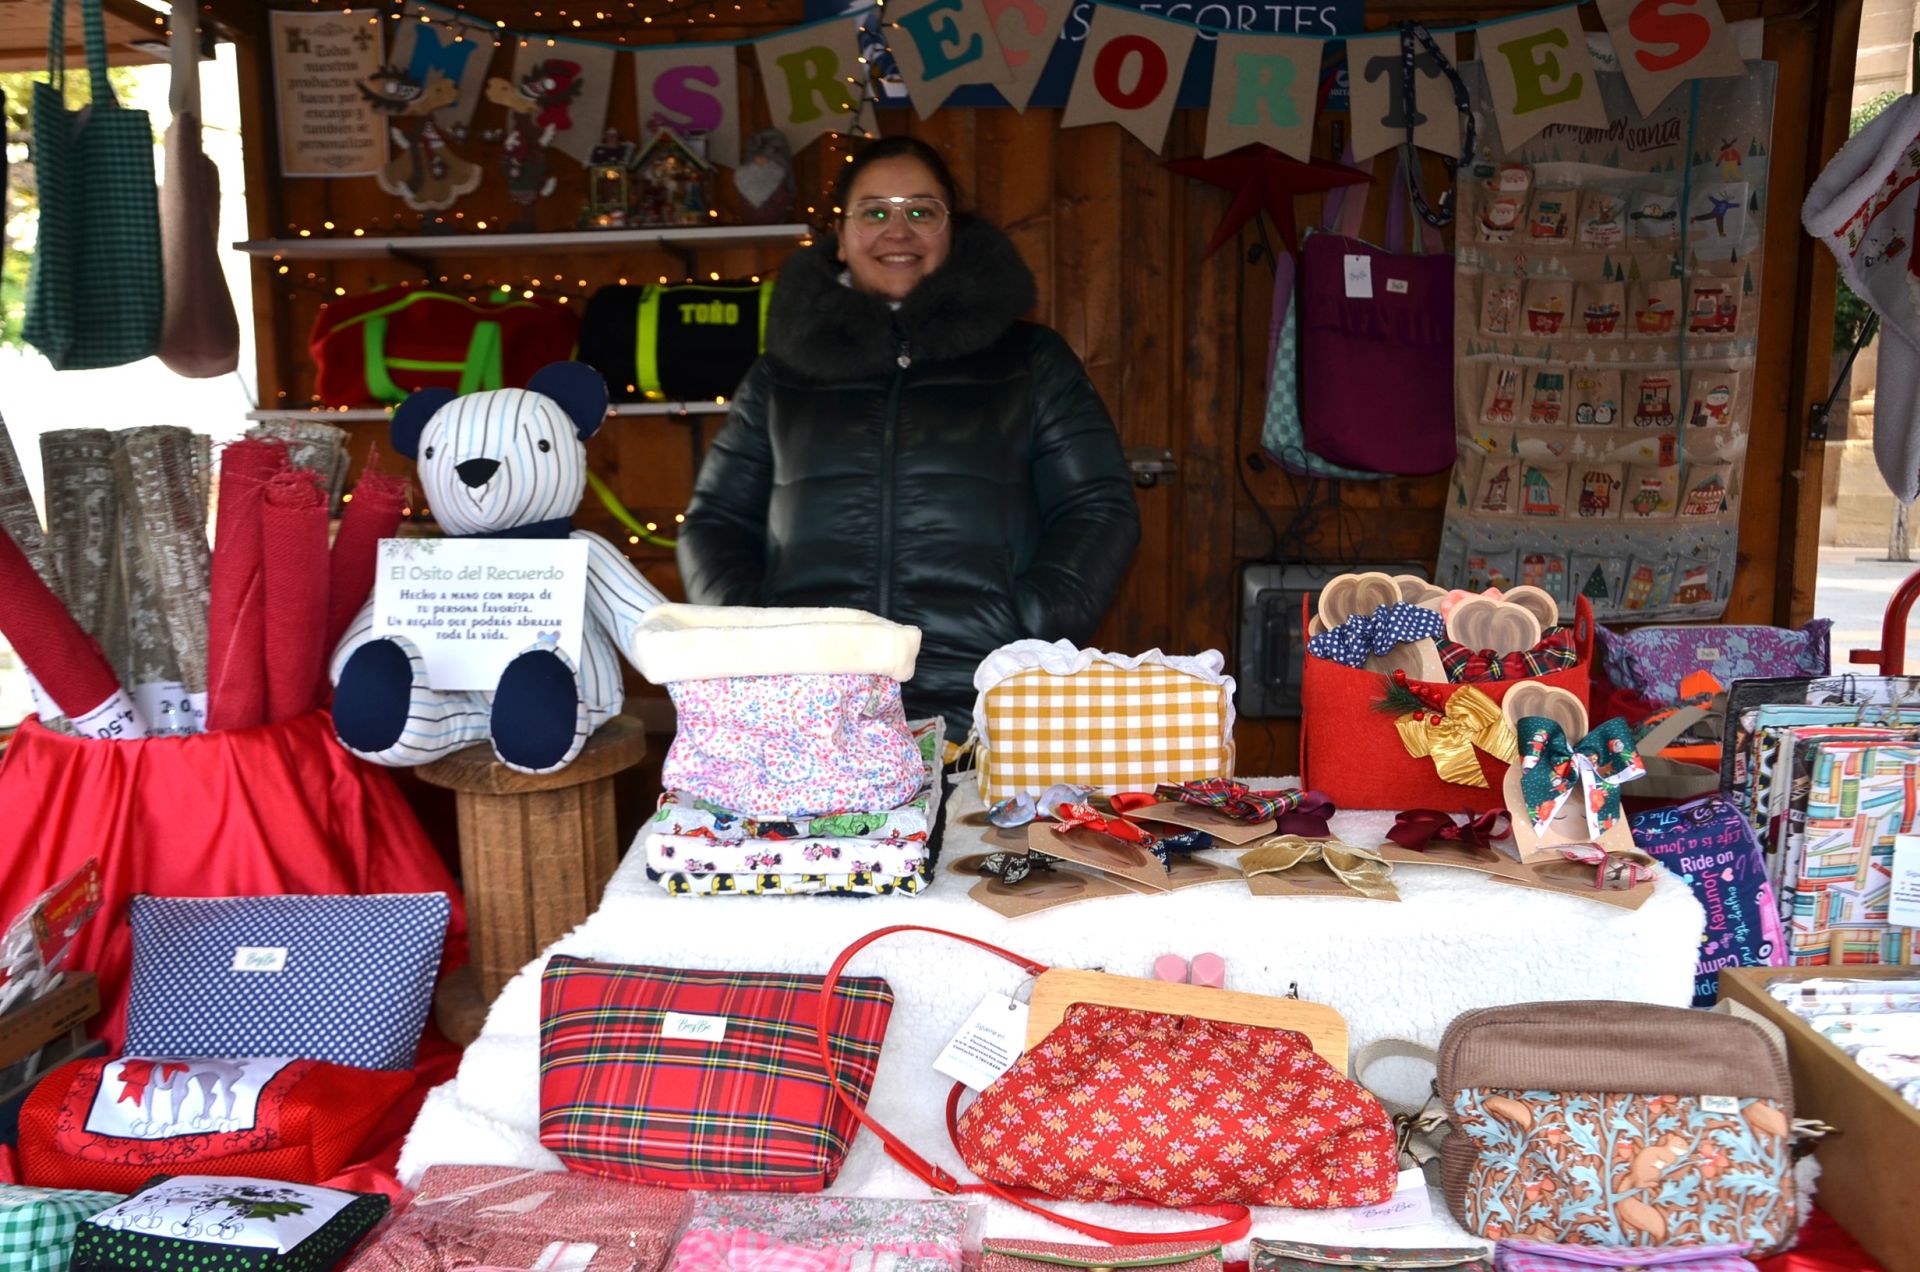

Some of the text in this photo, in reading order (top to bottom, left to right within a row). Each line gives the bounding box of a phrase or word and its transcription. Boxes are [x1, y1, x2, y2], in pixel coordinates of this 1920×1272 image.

[678, 299, 739, 325] TOÑO
[390, 565, 564, 581] El Osito del Recuerdo
[1701, 836, 1713, 848] is
[1717, 826, 1743, 848] Life
[1680, 854, 1714, 874] Ride
[1716, 851, 1735, 865] on
[1702, 870, 1728, 932] Journey
[1723, 886, 1741, 920] enjoy
